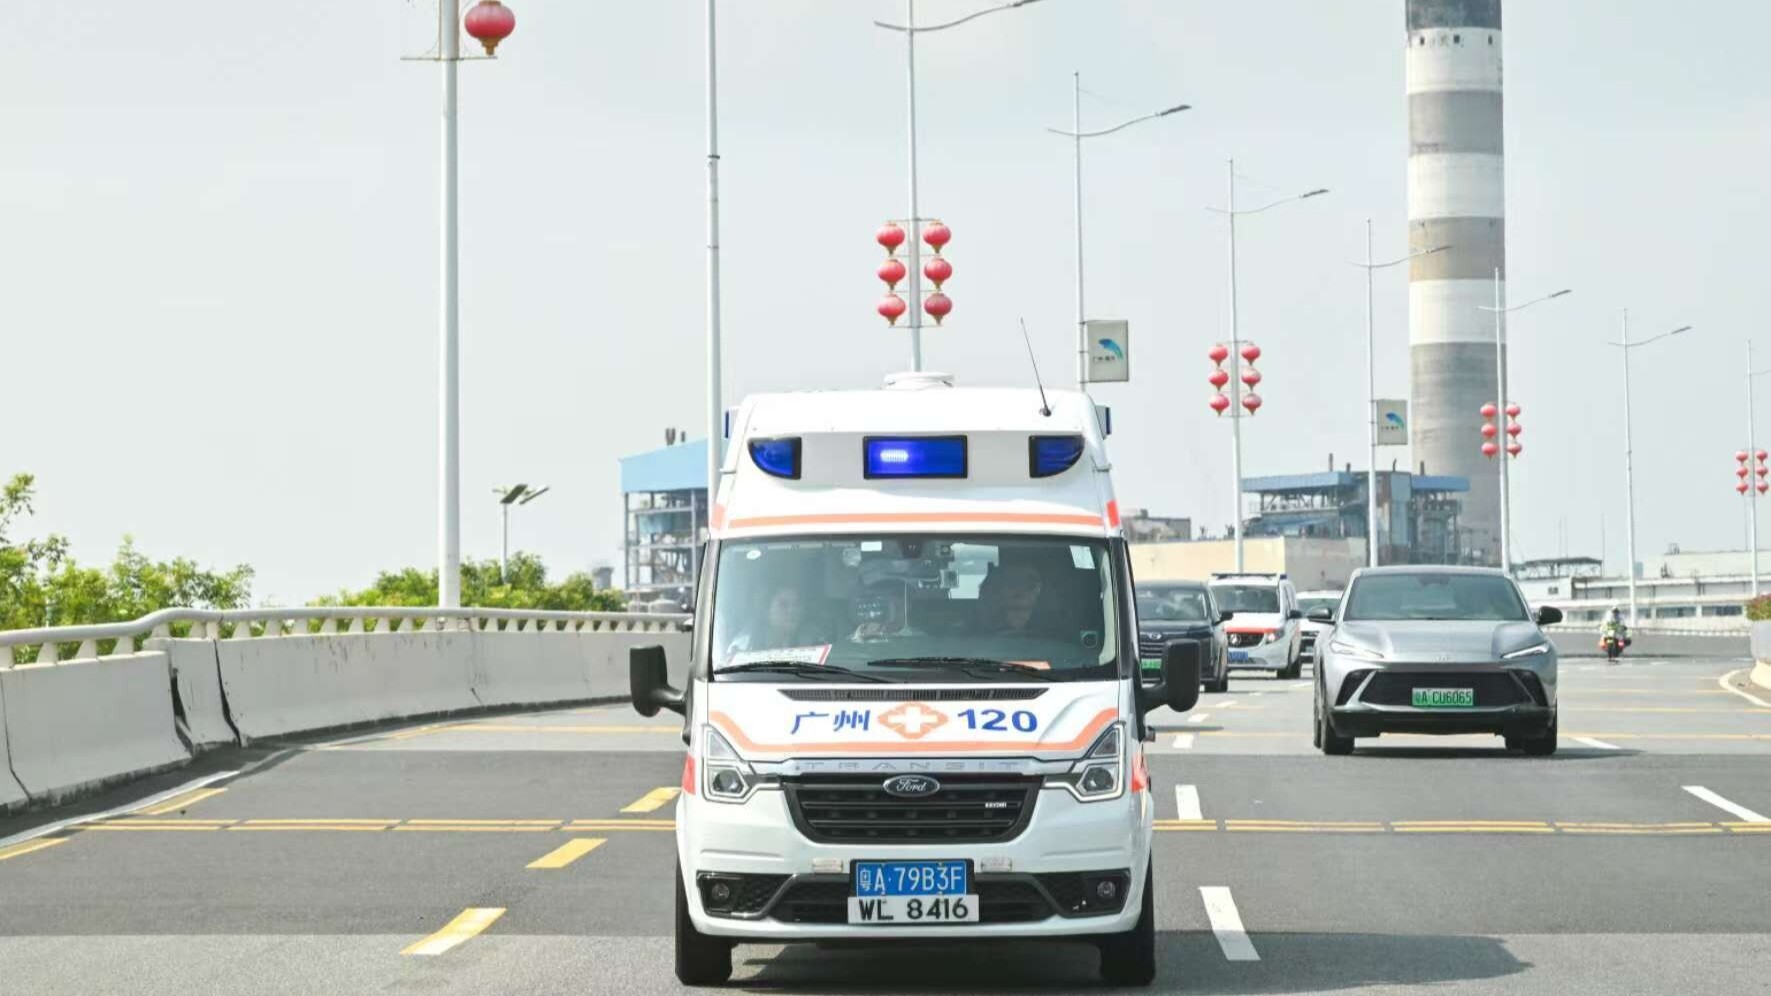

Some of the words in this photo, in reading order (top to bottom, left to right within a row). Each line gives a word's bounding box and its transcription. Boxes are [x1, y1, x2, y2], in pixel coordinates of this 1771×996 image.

[791, 710, 871, 734] 广州
[957, 708, 1038, 732] 120
[804, 761, 1019, 771] TRANSIT
[896, 777, 927, 792] Ford
[859, 866, 963, 892] 粤A·79B3F
[859, 899, 894, 921] WL
[907, 898, 968, 920] 8416
